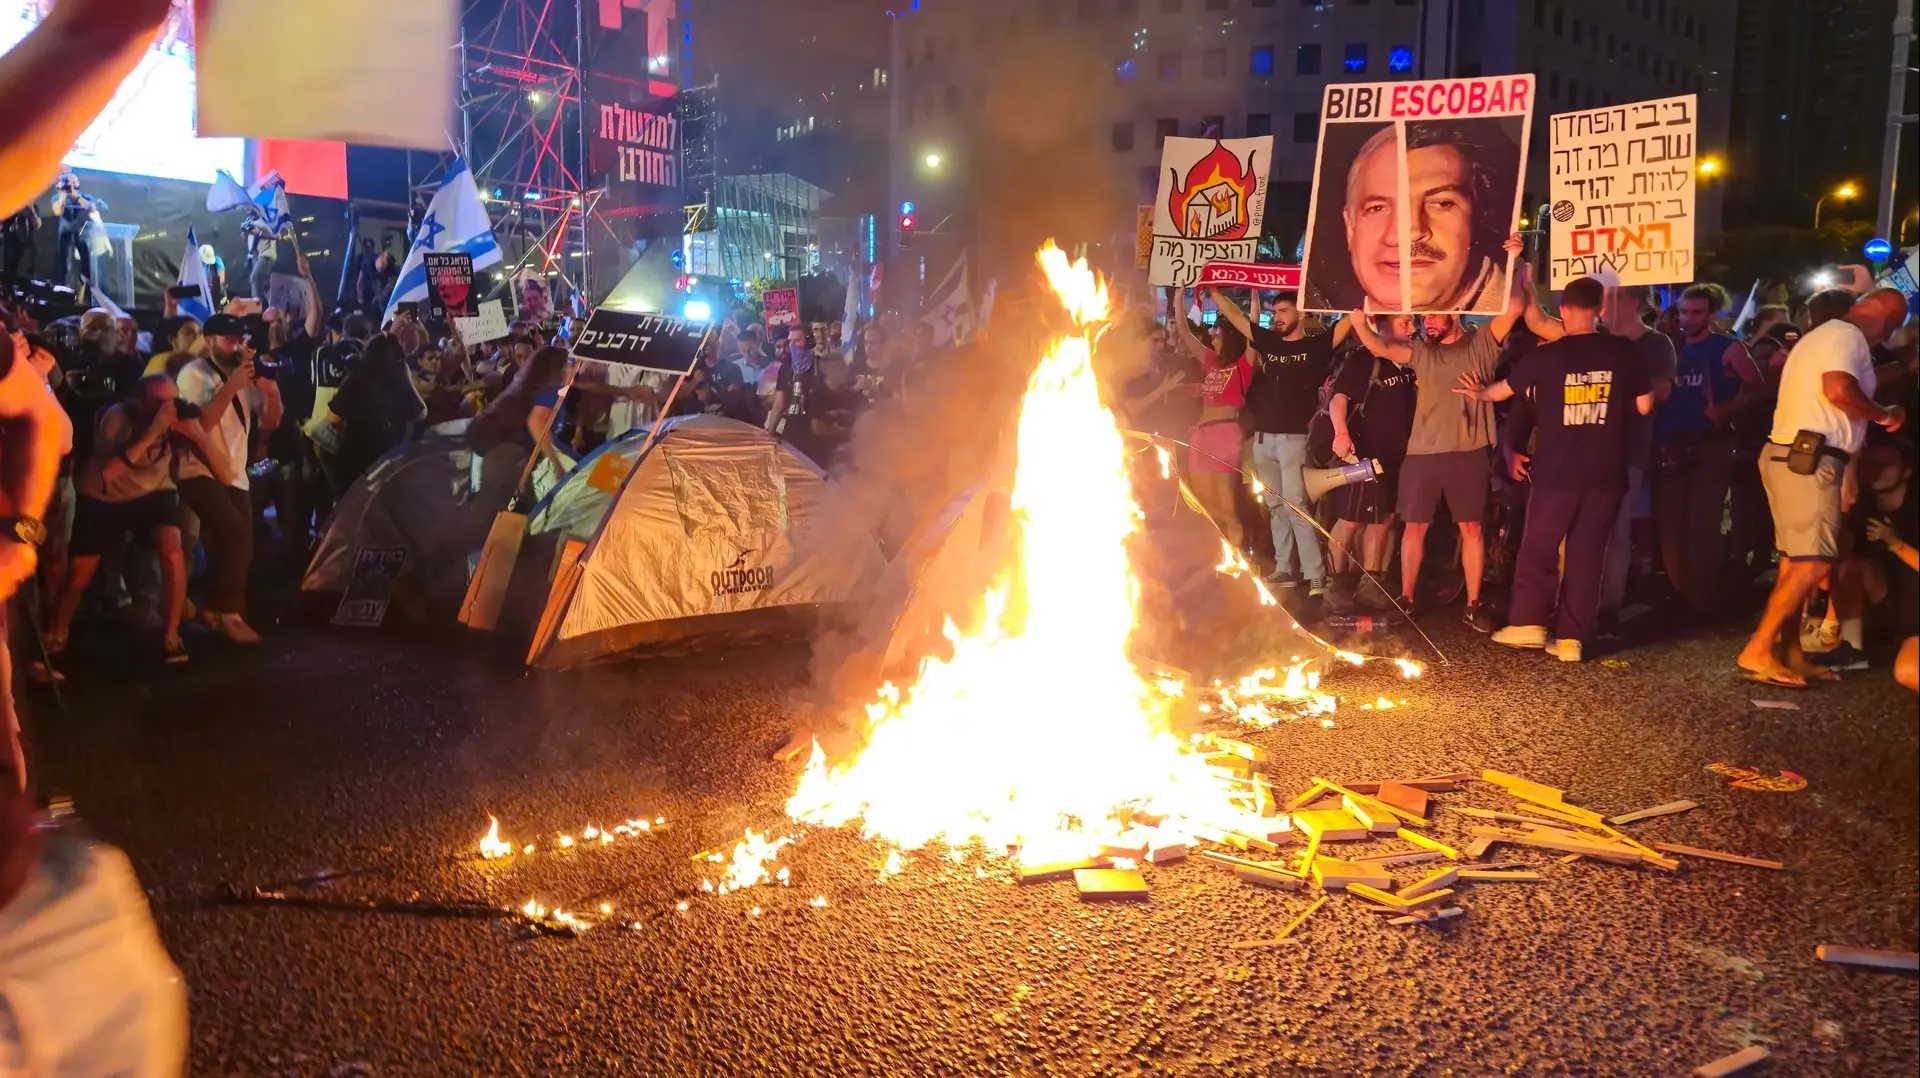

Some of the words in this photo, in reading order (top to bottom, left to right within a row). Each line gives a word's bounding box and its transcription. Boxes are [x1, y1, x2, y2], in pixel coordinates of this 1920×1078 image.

[1326, 87, 1382, 119] BIBI
[1391, 78, 1529, 117] ESCOBAR
[600, 102, 677, 150] לממשלת
[1553, 108, 1626, 145] הפחדן
[1633, 101, 1691, 130] ביבי
[1554, 147, 1583, 175] זה
[1588, 142, 1619, 171] מה
[1627, 133, 1692, 165] שכח
[618, 145, 677, 187] החורבן
[1564, 175, 1615, 201] יהודי
[1627, 165, 1689, 195] להיות
[1575, 199, 1687, 229] ביהדות
[1159, 240, 1184, 257] מה
[1190, 242, 1251, 263] והצפון
[1571, 222, 1672, 256] האדם
[1211, 269, 1248, 281] כהנא
[1553, 248, 1629, 278] לאדמה
[1634, 249, 1689, 276] קודם
[1254, 272, 1287, 285] אנטי
[580, 330, 652, 351] דרכנים
[637, 316, 705, 338] ביקורת
[1291, 352, 1308, 362] דור
[1564, 372, 1584, 386] ALL
[1587, 370, 1613, 384] THEM
[1564, 383, 1611, 405] HOME!
[1563, 402, 1608, 426] NOW!
[711, 565, 774, 589] OUTDOOR
